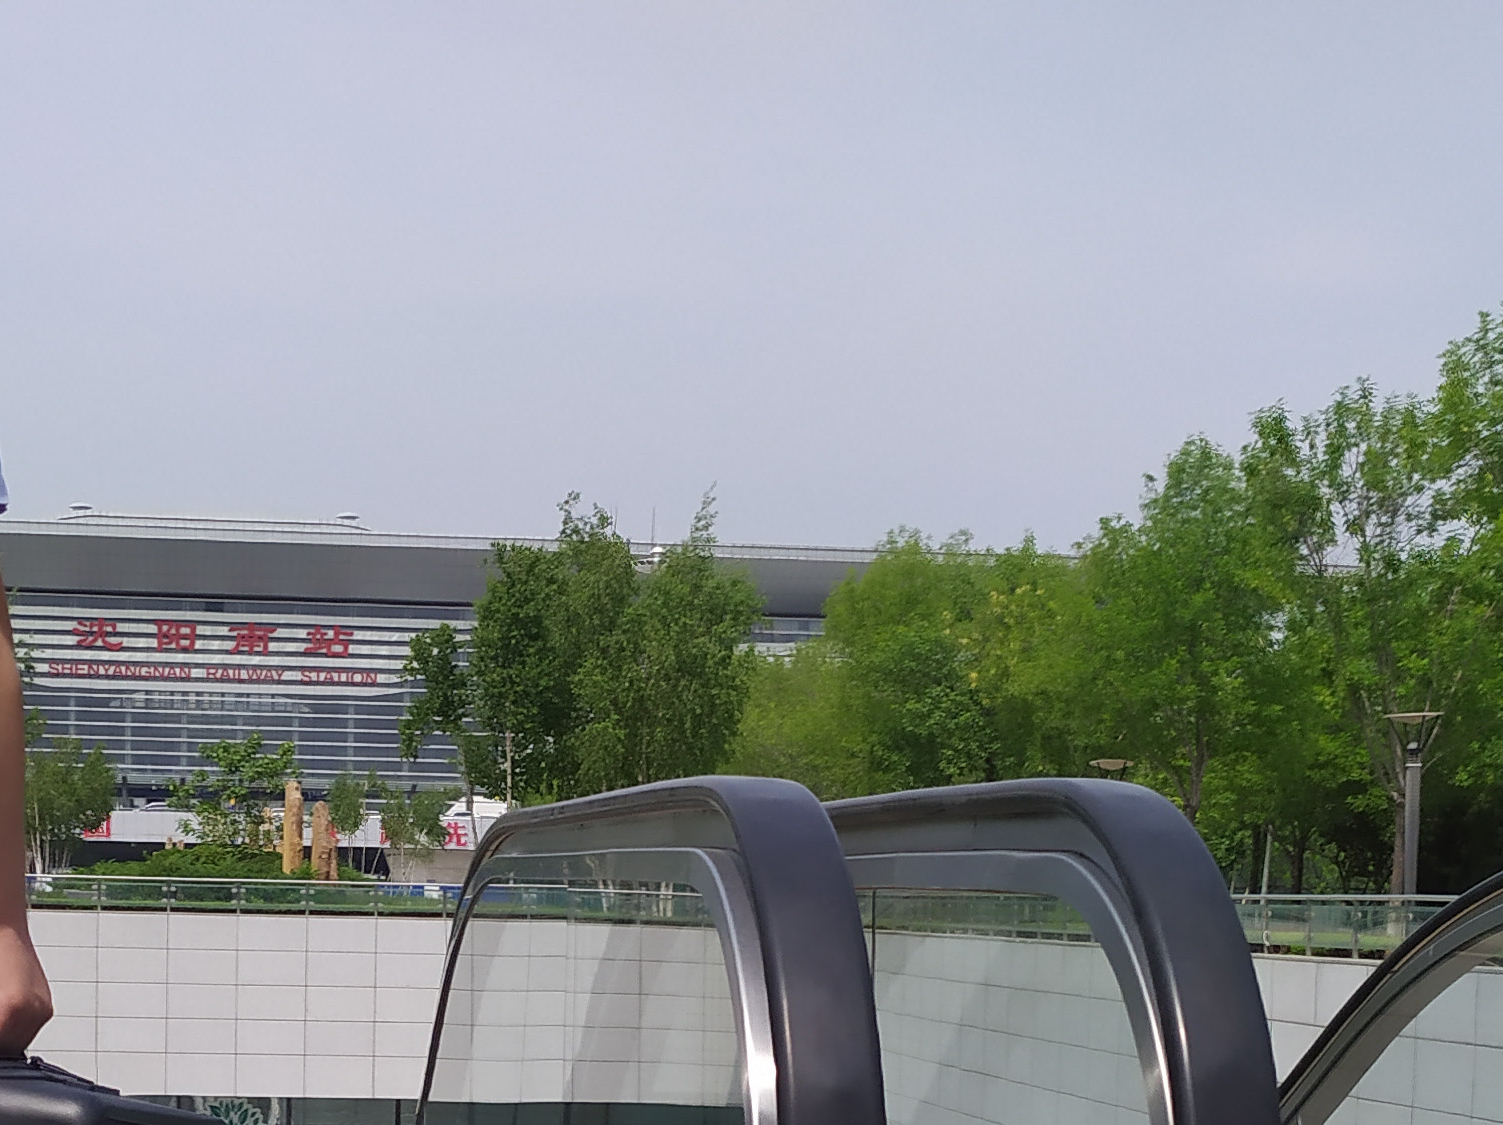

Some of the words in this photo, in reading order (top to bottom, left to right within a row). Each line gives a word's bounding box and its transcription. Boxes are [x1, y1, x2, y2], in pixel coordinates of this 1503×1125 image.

[72, 617, 355, 658] 沈阳南站
[48, 661, 192, 681] SHENYANGNAN
[205, 666, 285, 682] RAILWAY
[300, 669, 378, 685] STATION
